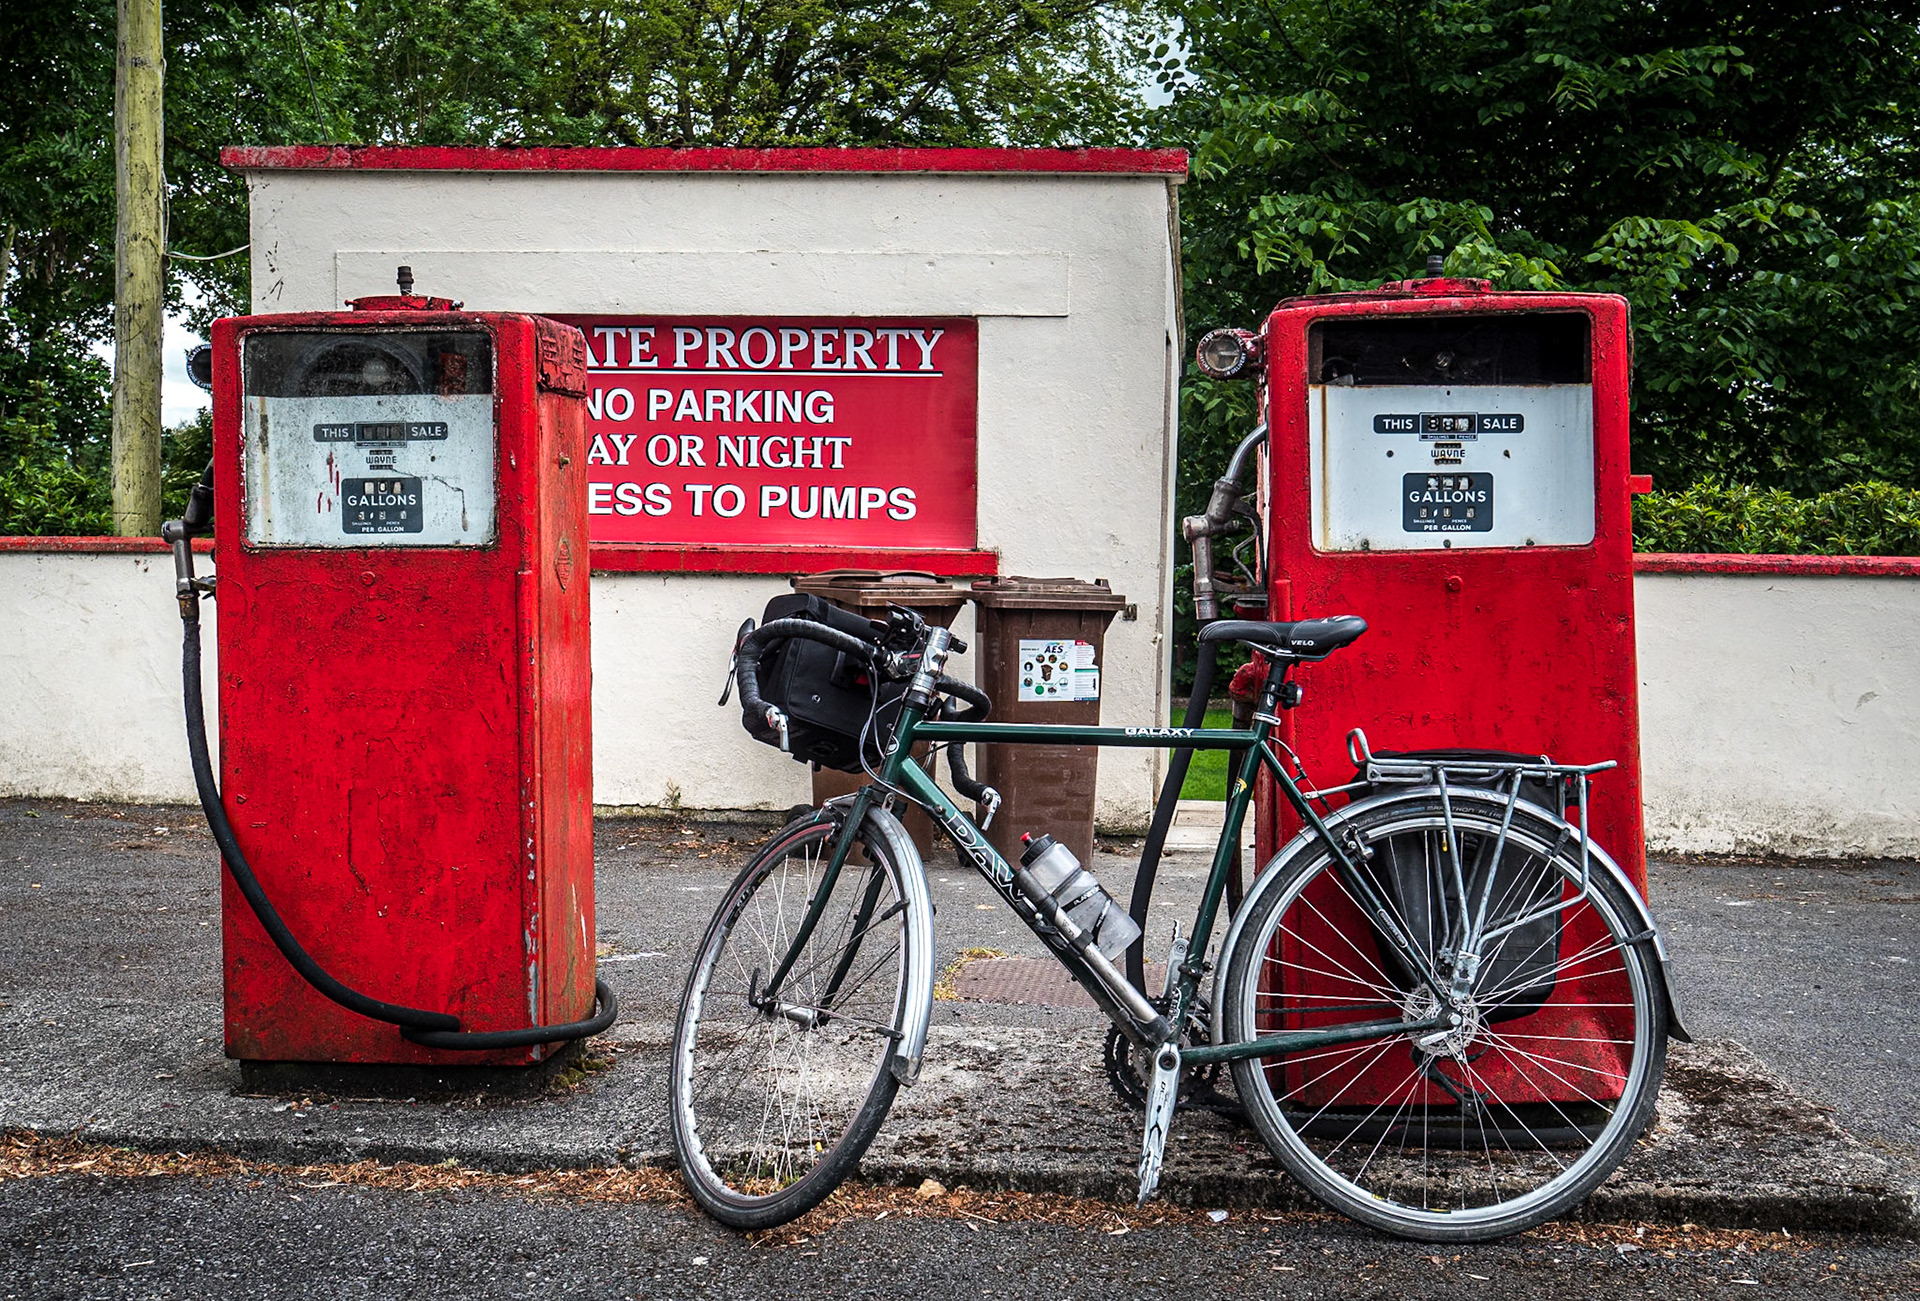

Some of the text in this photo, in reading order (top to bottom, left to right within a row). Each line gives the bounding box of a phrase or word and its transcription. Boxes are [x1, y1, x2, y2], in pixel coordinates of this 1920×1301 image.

[579, 326, 945, 371] ATE PROPERTY
[587, 387, 835, 423] NO PARKING
[1382, 419, 1413, 430] THIS
[1483, 418, 1517, 429] SALE
[321, 426, 441, 437] THIS SALE
[587, 433, 852, 469] AY OR NIGHT
[365, 456, 397, 464] WAYNE
[347, 494, 417, 506] GALLONS
[588, 482, 917, 520] ESS TO PUMPS
[1409, 490, 1487, 503] GALLONS
[1044, 645, 1064, 654] AES
[1125, 727, 1195, 736] GALAXY
